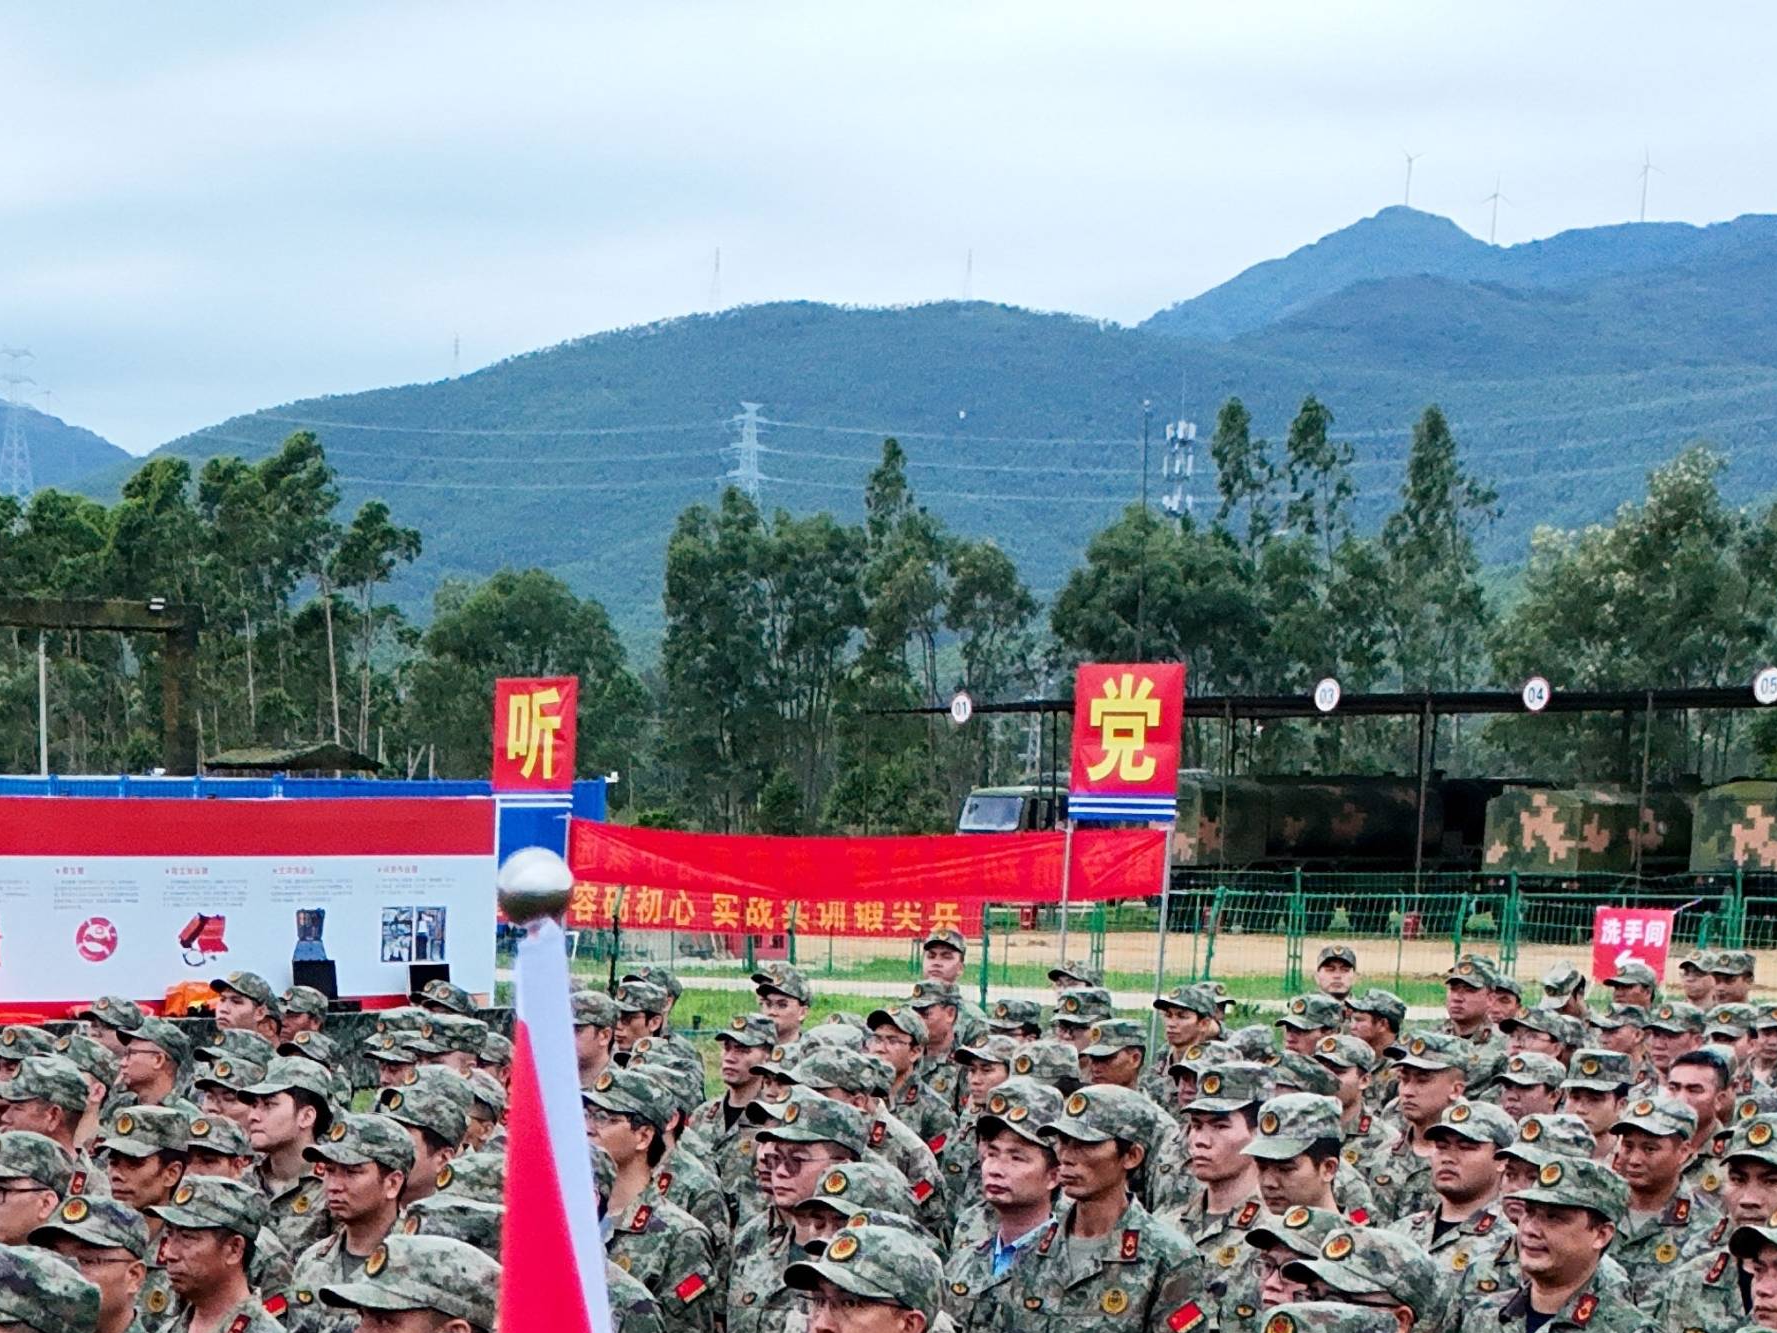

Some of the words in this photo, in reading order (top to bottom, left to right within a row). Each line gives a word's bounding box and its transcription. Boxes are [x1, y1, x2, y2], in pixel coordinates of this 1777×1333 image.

[1760, 676, 1777, 694] 05
[1319, 687, 1334, 704] 03
[1527, 686, 1544, 703] 04
[953, 701, 968, 716] 01
[506, 687, 561, 780] 听
[1087, 672, 1161, 782] 党
[1600, 917, 1667, 948] 洗手间
